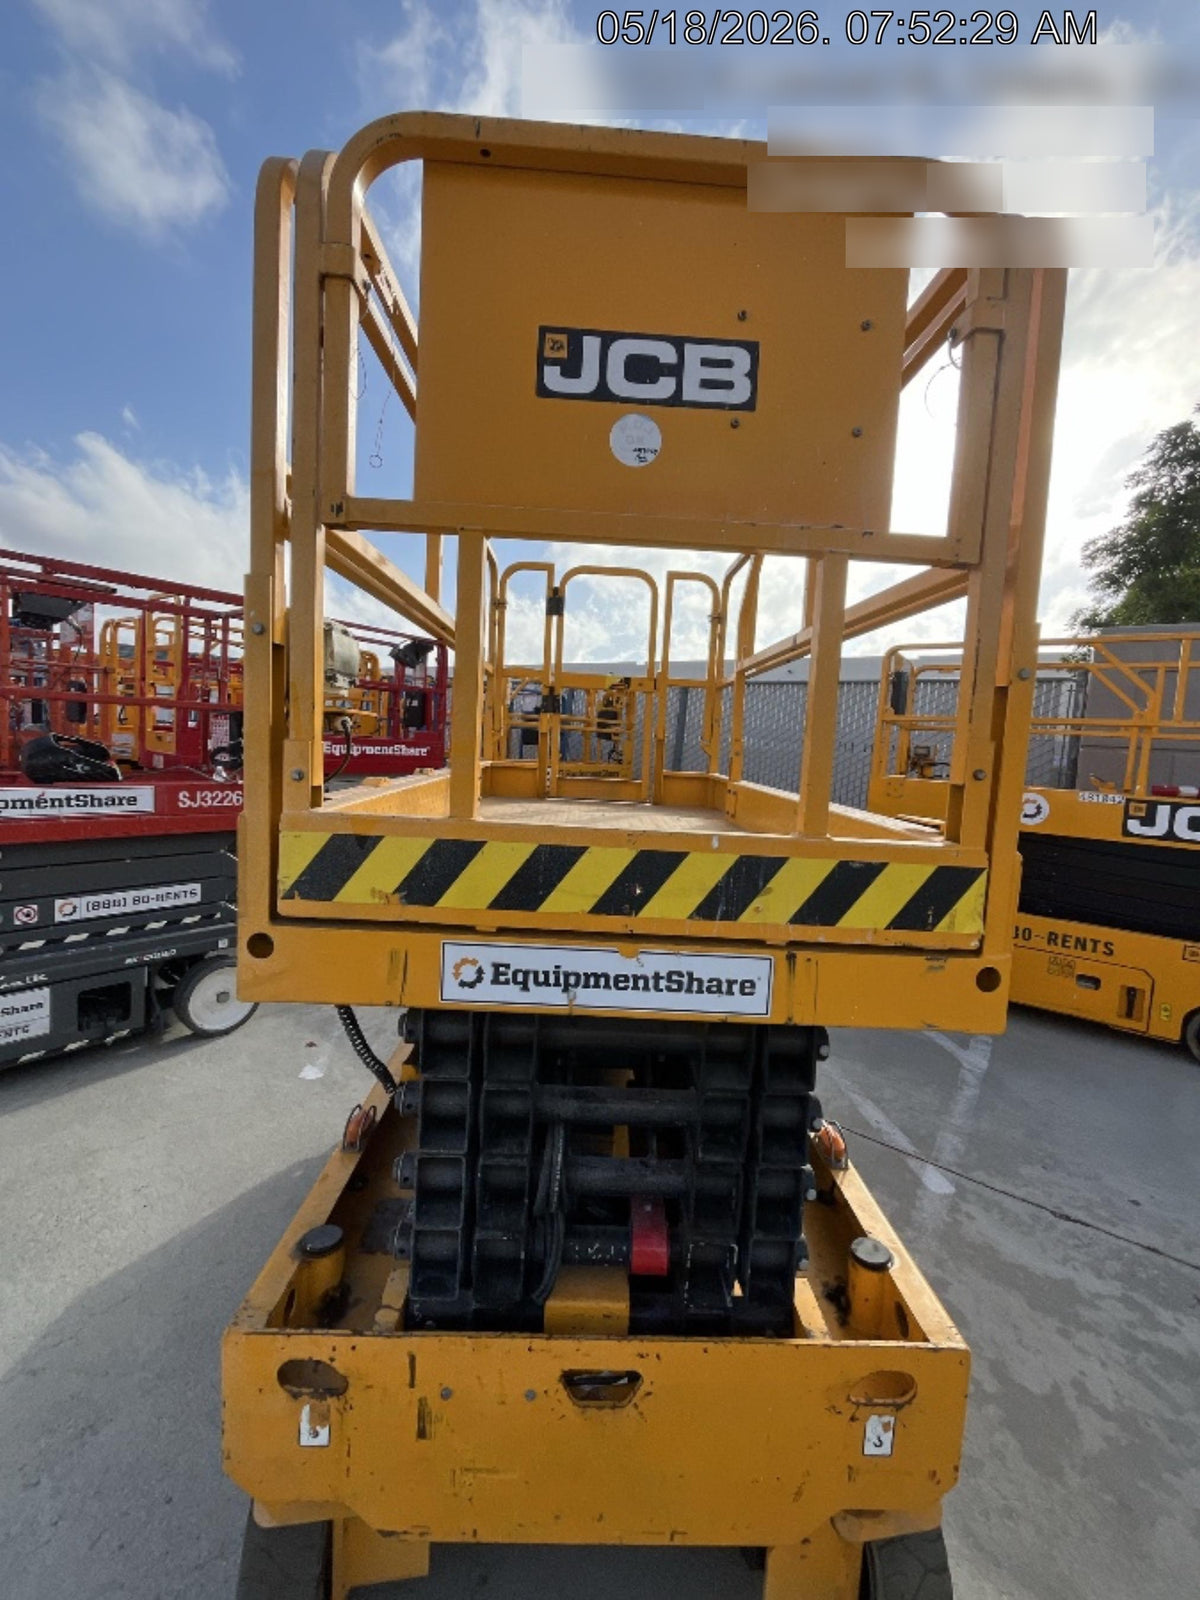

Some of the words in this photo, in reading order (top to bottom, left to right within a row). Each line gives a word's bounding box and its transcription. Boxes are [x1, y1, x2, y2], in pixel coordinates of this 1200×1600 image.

[543, 335, 752, 404] JCB
[178, 790, 243, 808] SJ3226
[490, 962, 757, 997] EquipmentShare
